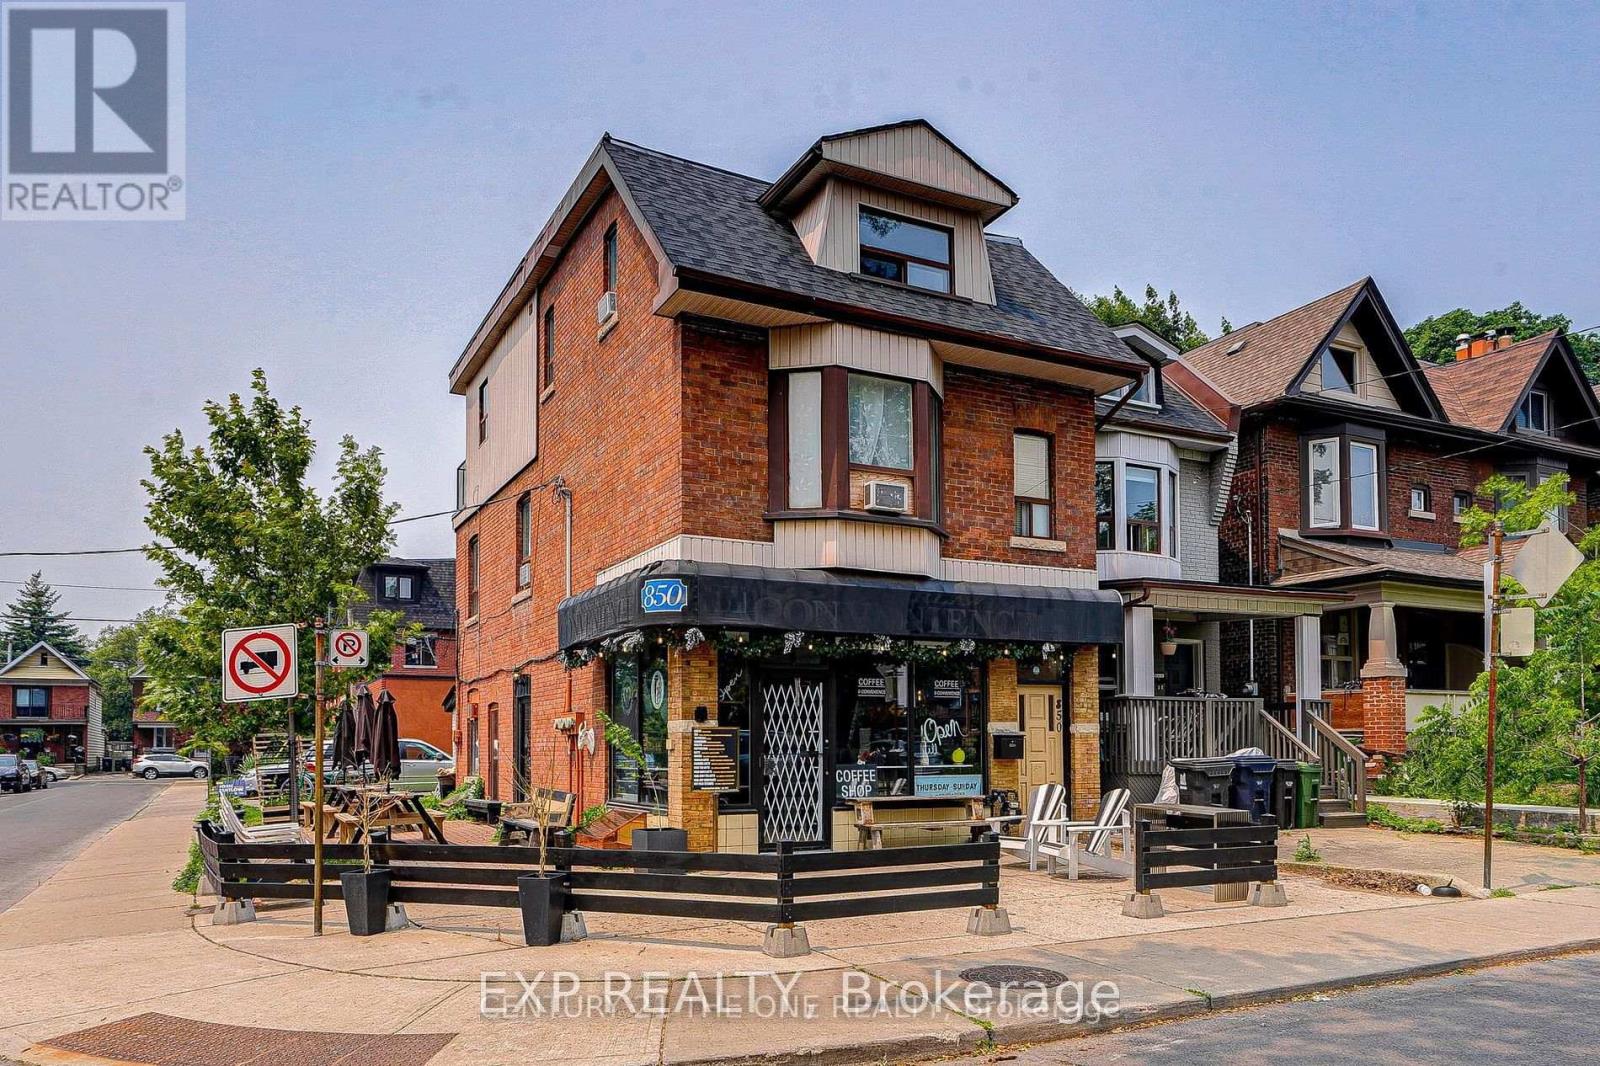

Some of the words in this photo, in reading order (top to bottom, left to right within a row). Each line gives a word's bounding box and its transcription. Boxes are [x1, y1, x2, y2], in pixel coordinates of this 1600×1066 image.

[644, 584, 682, 608] 850
[858, 678, 885, 686] COFFEE
[934, 679, 959, 687] COFFEE
[924, 718, 969, 747] Open
[836, 770, 876, 782] COFFEE
[841, 784, 872, 798] SHOP
[916, 783, 950, 792] THURSDAY
